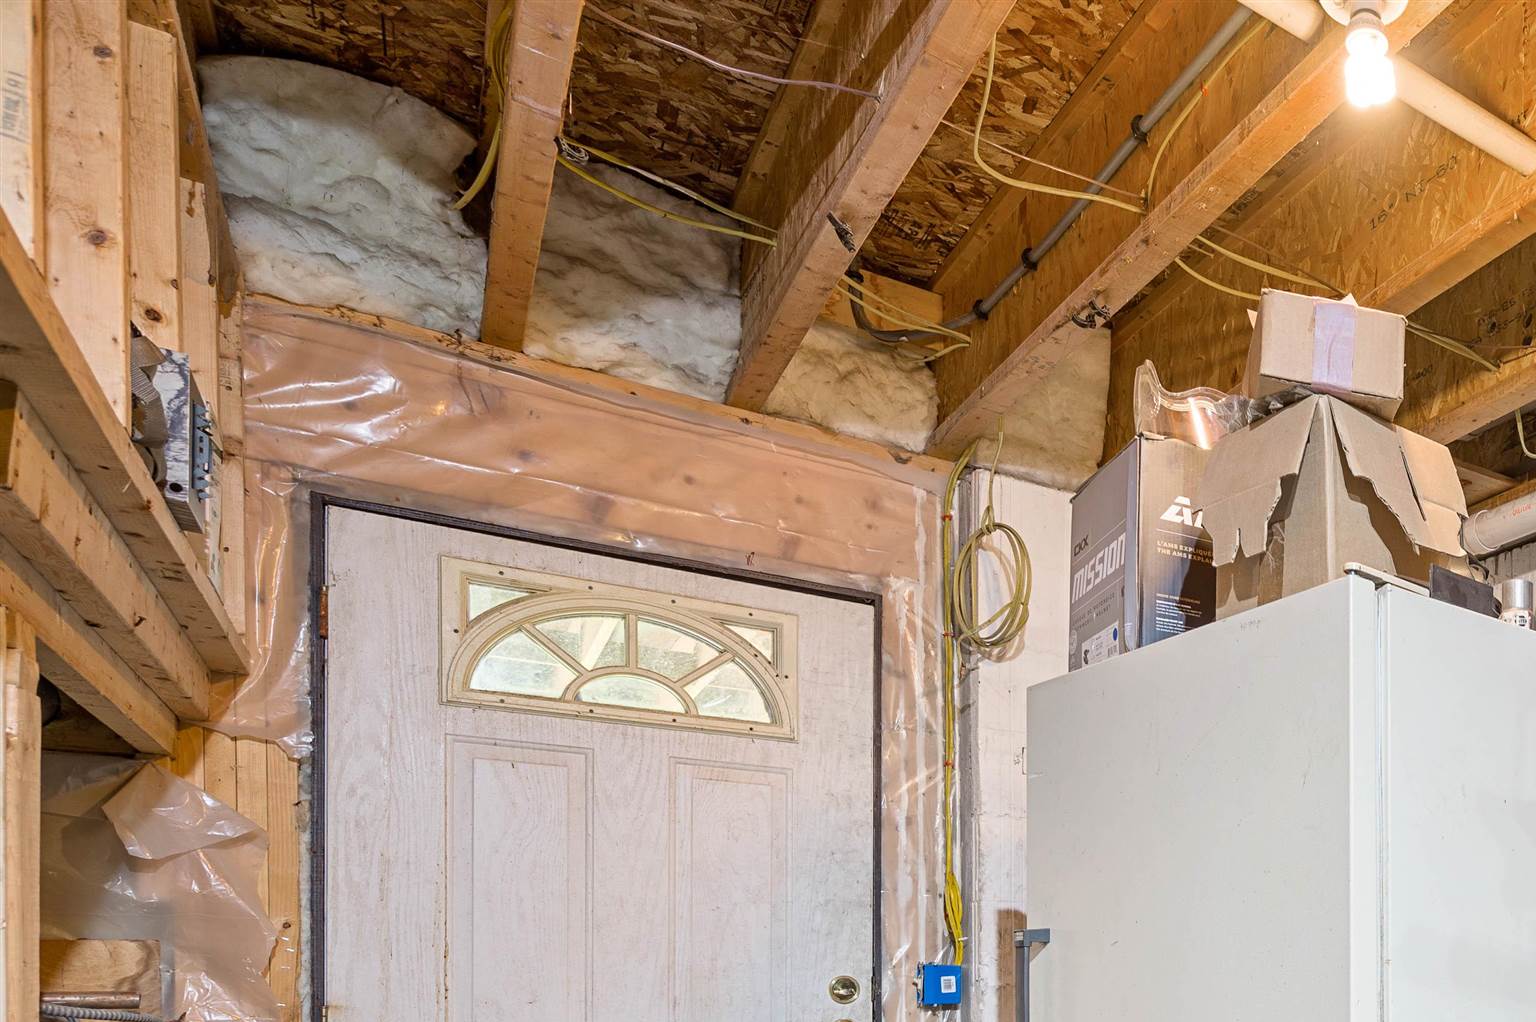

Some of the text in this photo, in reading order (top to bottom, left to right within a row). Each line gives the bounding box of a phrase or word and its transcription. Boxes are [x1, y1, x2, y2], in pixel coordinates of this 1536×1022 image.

[1072, 533, 1126, 604] MISSION
[1157, 547, 1171, 555] THE
[1172, 550, 1187, 559] AMS
